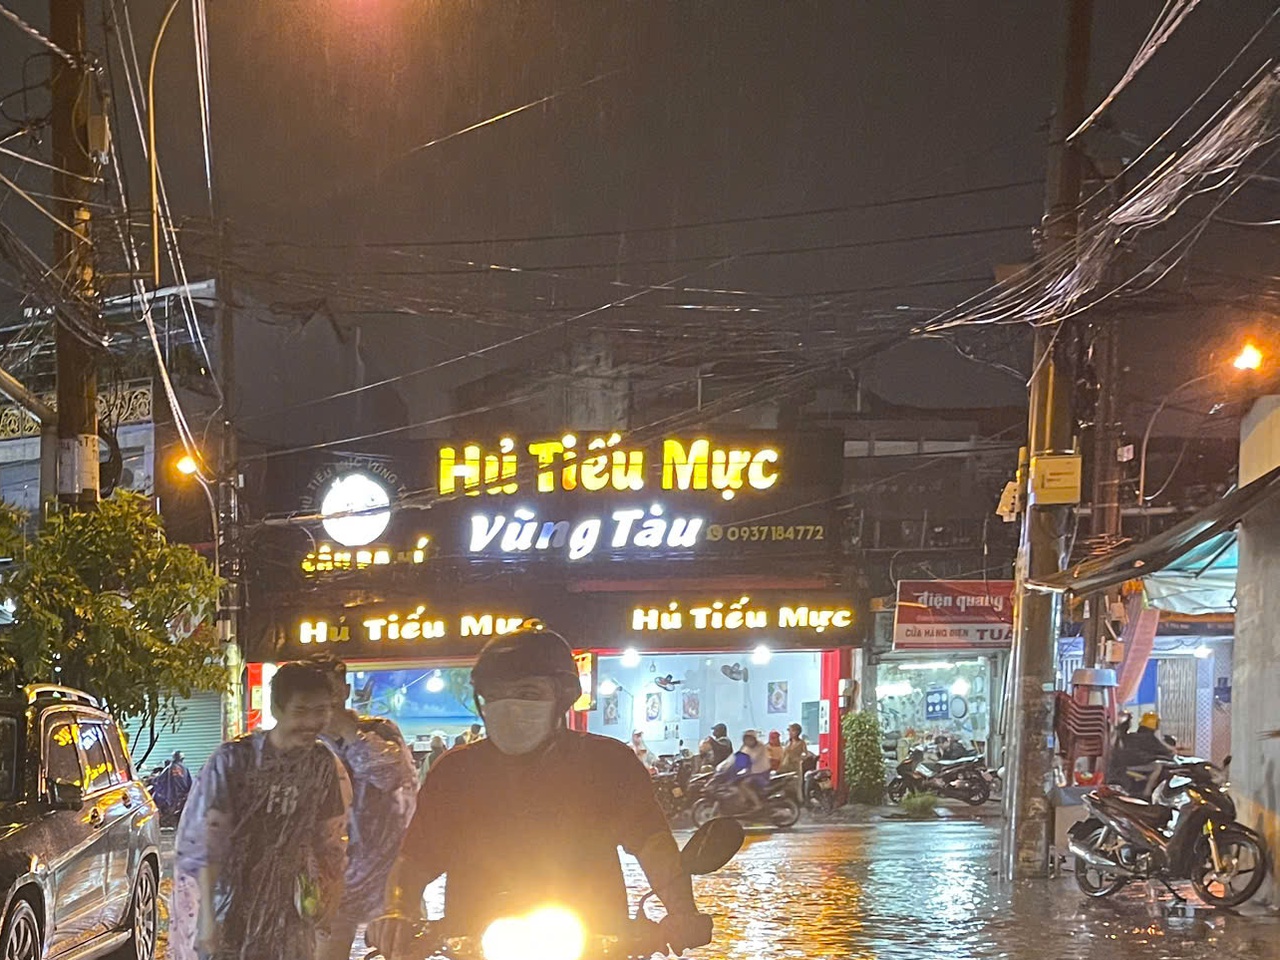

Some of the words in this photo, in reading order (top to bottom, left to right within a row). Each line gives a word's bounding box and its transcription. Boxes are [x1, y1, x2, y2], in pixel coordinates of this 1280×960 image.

[439, 437, 519, 496] Hủ
[528, 433, 645, 492] Tiếu
[661, 439, 779, 500] Mực
[632, 601, 683, 631] Hủ
[689, 596, 768, 630] Tiếu
[778, 606, 853, 633] Mực
[913, 590, 953, 609] điện
[299, 615, 351, 644] Hủ
[363, 606, 446, 641] Tiếu
